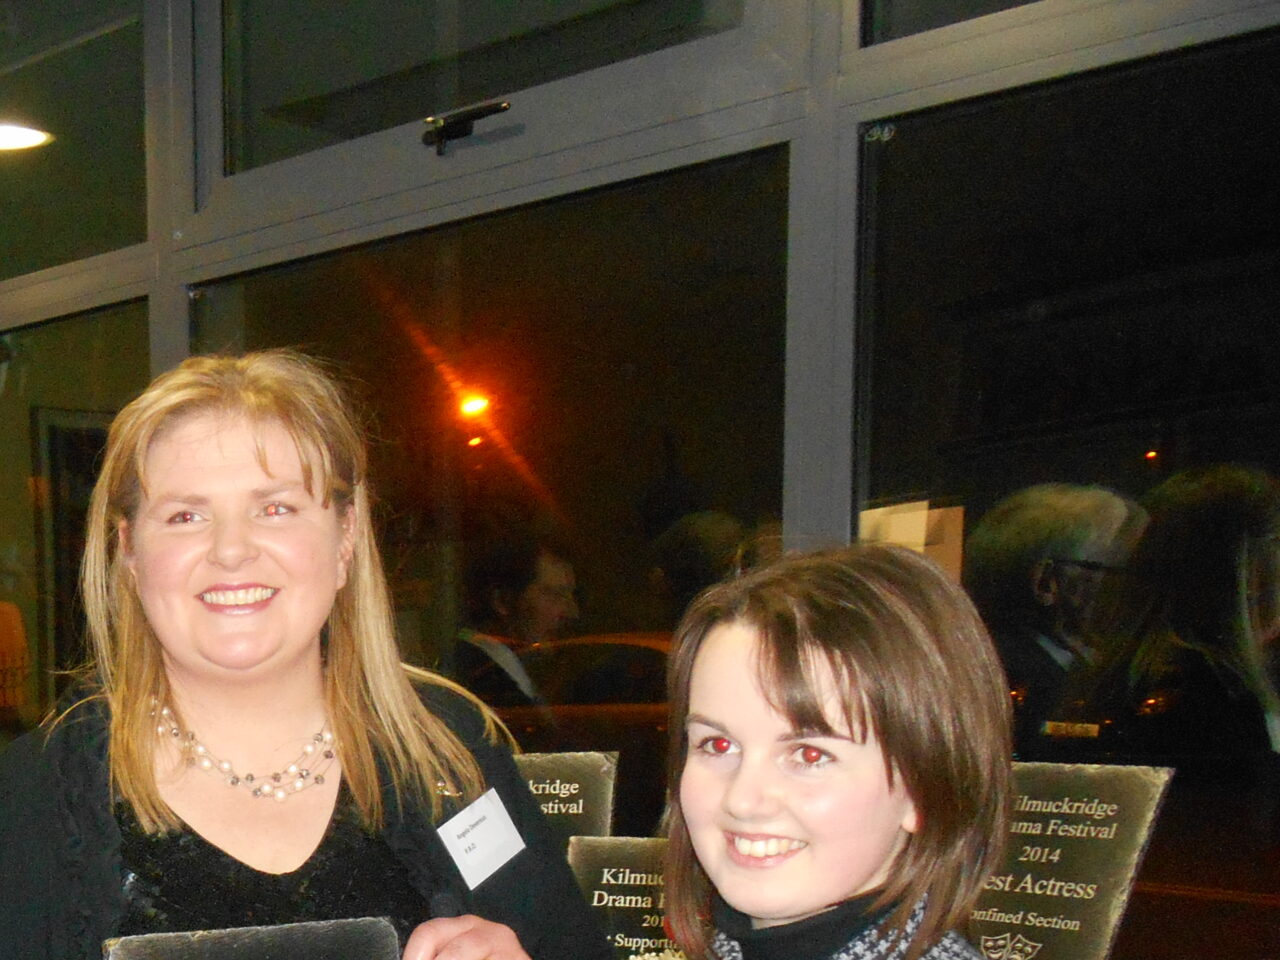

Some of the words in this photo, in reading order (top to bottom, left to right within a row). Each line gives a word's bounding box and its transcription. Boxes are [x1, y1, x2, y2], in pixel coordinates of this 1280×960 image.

[529, 779, 580, 798] kridge
[540, 799, 584, 814] stival
[1016, 796, 1118, 819] ilmuckridge
[1046, 820, 1117, 838] Festival
[1018, 846, 1061, 863] 2014
[984, 874, 1014, 891] est
[1014, 873, 1098, 899] Actress
[592, 890, 653, 908] Drama
[641, 914, 664, 927] 201
[1024, 912, 1081, 931] Section
